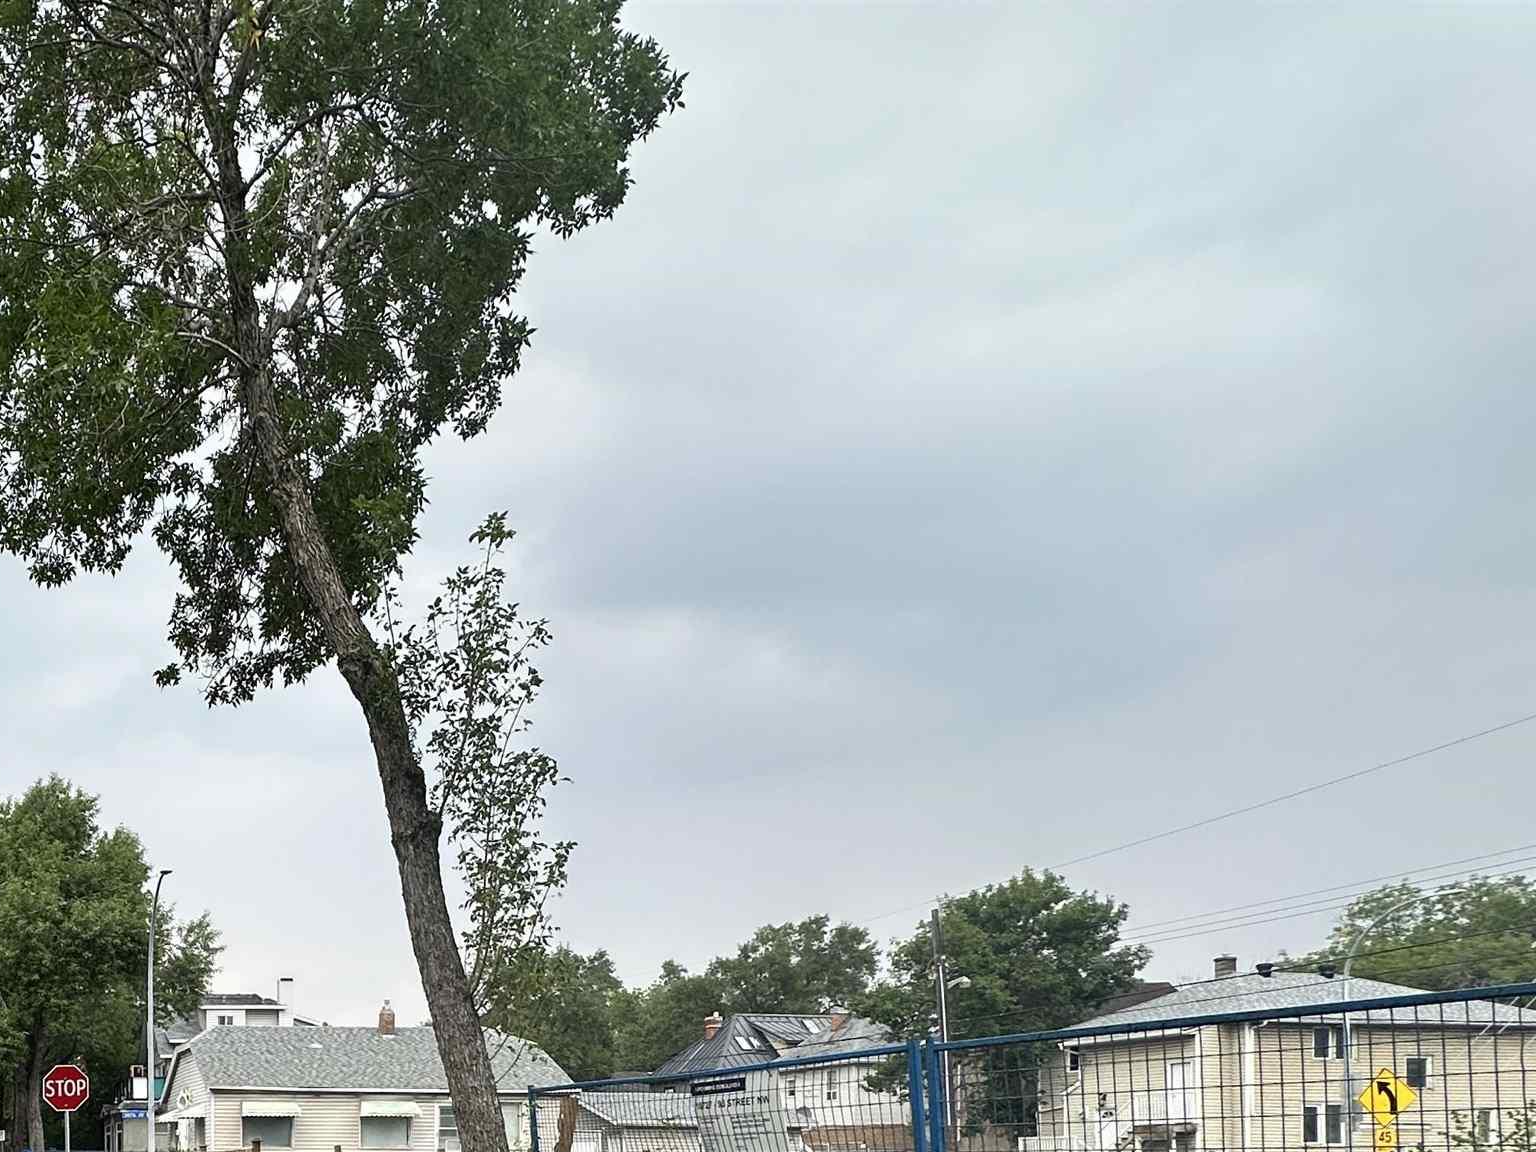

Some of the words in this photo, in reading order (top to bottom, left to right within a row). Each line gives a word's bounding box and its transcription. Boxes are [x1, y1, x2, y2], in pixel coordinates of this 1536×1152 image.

[46, 1080, 86, 1097] STOP
[727, 1096, 755, 1108] STREET
[1379, 1131, 1392, 1143] 45
